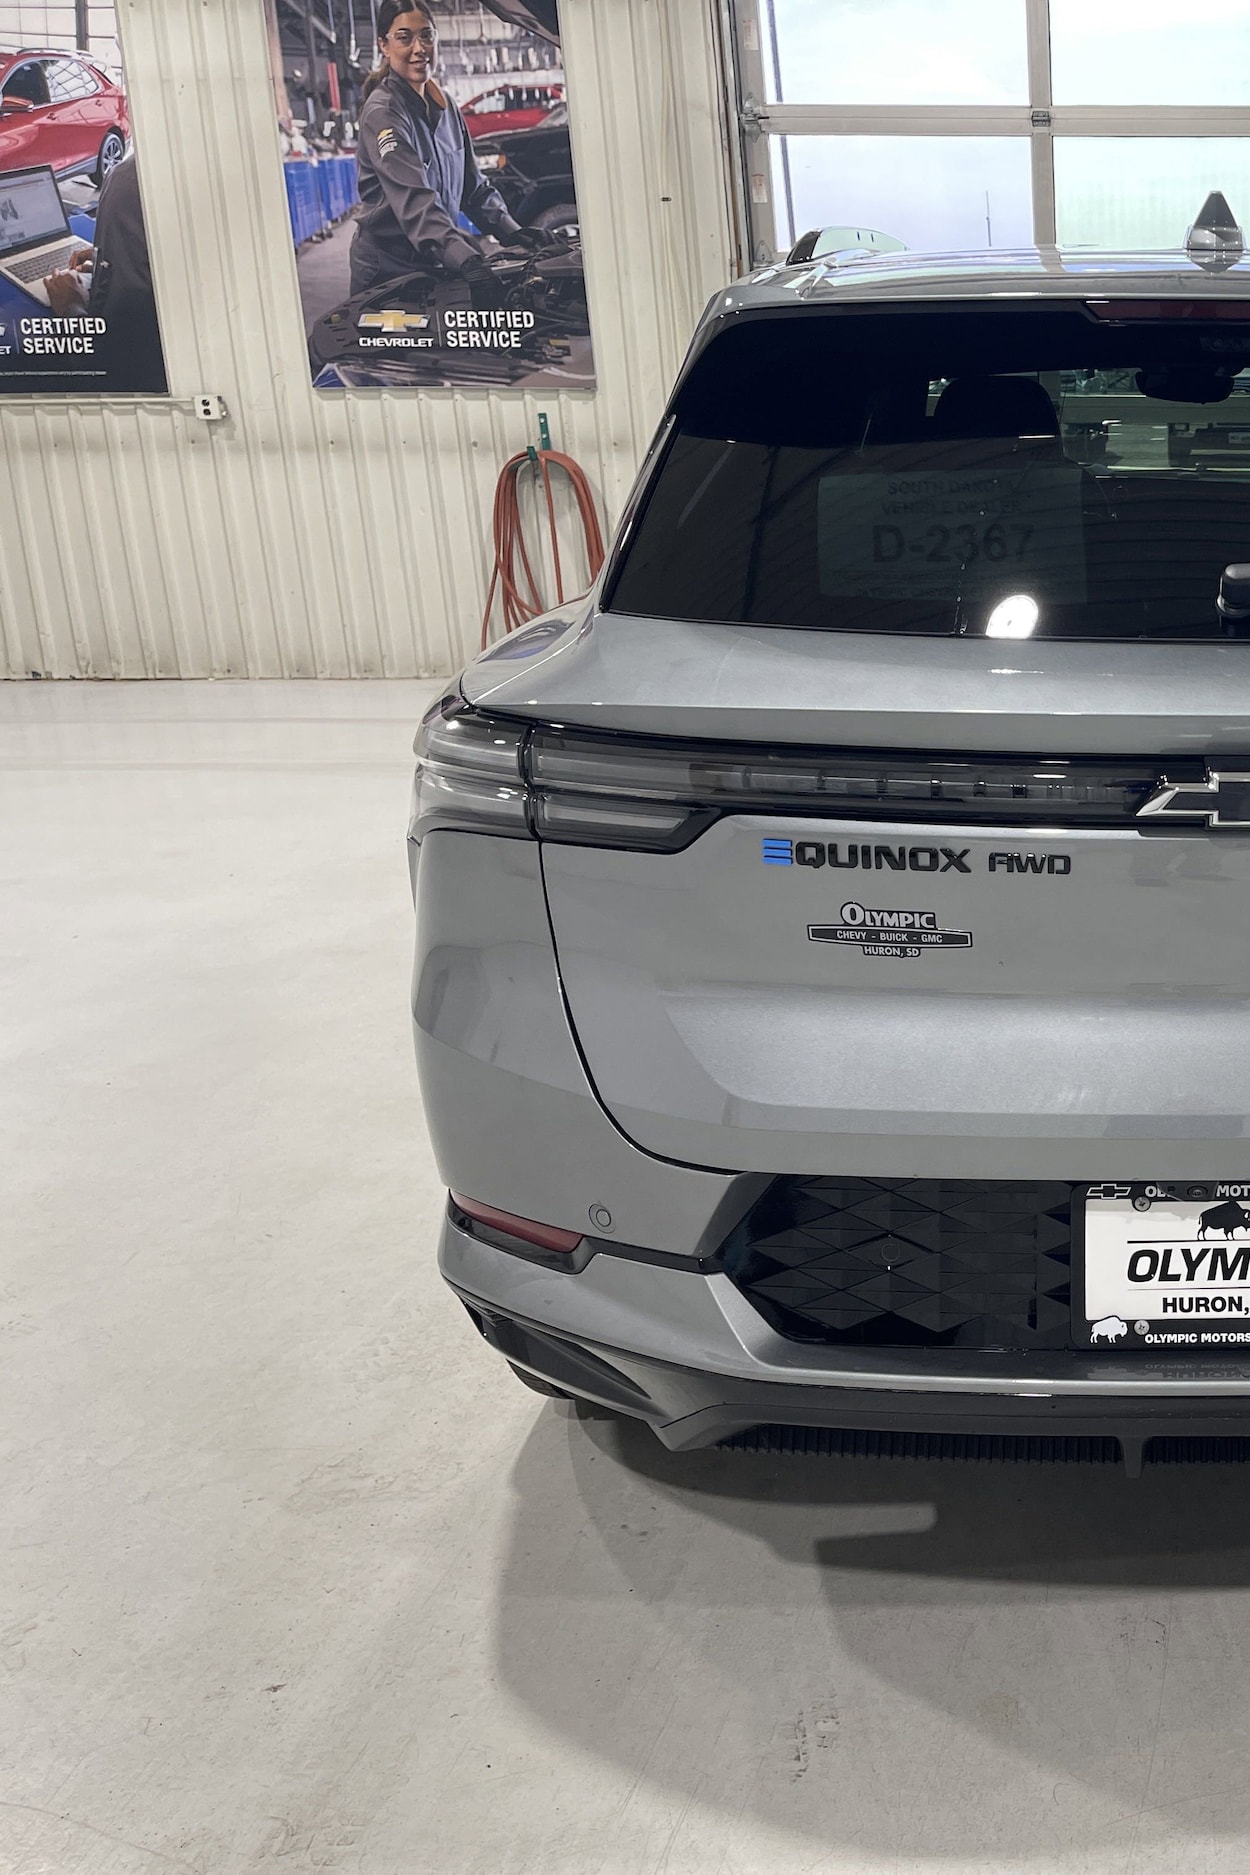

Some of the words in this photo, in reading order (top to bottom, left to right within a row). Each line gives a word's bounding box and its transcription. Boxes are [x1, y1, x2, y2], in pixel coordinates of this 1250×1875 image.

[20, 317, 107, 335] CERTIFIED
[444, 310, 535, 329] CERTIFIED
[23, 337, 95, 355] SERVICE
[358, 337, 434, 348] CHEVROLET
[446, 330, 522, 348] SERVICE
[872, 523, 1035, 563] D-2367
[761, 837, 972, 874] EQUINOX
[988, 852, 1071, 875] AWD
[841, 903, 935, 929] OLYMPIC
[836, 930, 867, 940] CHEVY
[880, 932, 909, 942] BUICK
[921, 934, 943, 943] GMC
[864, 946, 904, 957] HURON,
[906, 948, 919, 957] SD
[1162, 1295, 1250, 1316] HURON,
[1144, 1332, 1198, 1344] OLYMPIC
